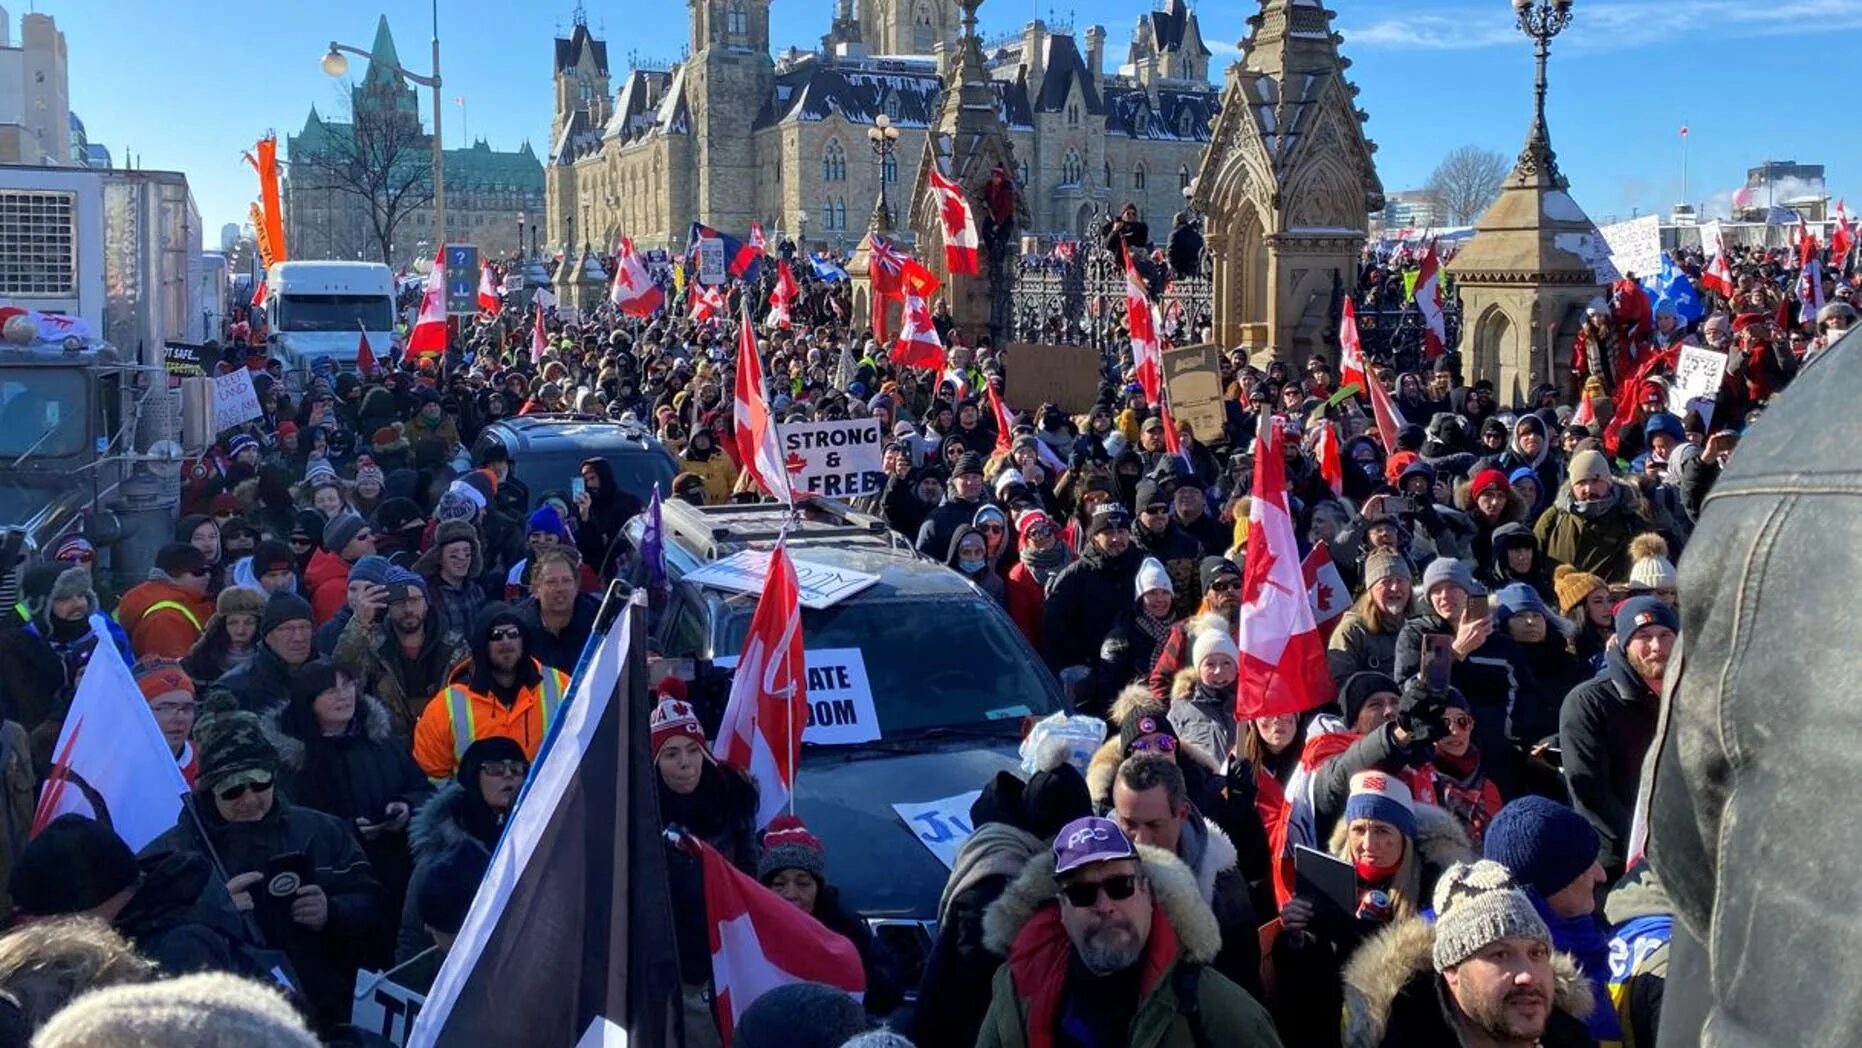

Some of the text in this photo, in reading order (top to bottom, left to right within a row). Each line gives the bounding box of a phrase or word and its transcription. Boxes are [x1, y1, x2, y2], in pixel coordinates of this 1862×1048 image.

[786, 427, 877, 450] STRONG
[826, 452, 841, 468] &
[805, 665, 851, 691] ATE
[1068, 828, 1109, 849] PPC
